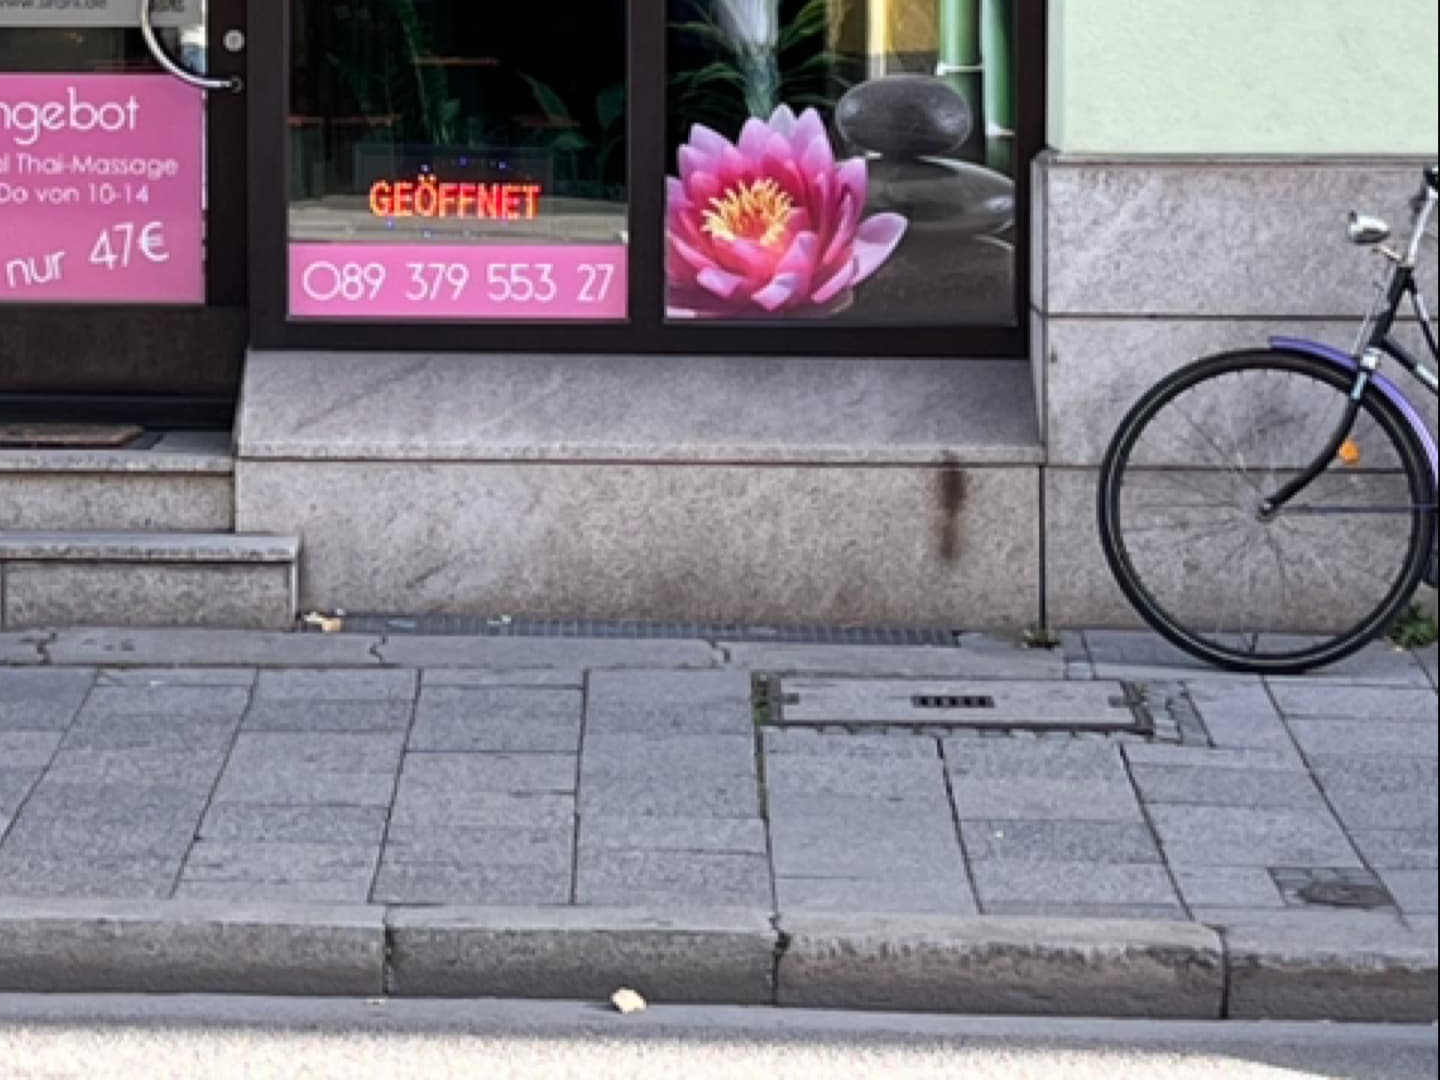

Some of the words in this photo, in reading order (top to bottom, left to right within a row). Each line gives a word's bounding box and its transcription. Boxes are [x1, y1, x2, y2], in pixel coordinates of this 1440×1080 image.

[15, 151, 179, 181] Thai-Massage
[35, 186, 80, 205] von
[88, 182, 150, 205] 10-14
[368, 174, 542, 221] GEÖFFNET
[5, 249, 66, 288] nur
[88, 220, 170, 271] 47€
[301, 260, 387, 303] 089
[404, 262, 470, 303] 379
[486, 262, 558, 303] 553
[576, 262, 616, 303] 27
